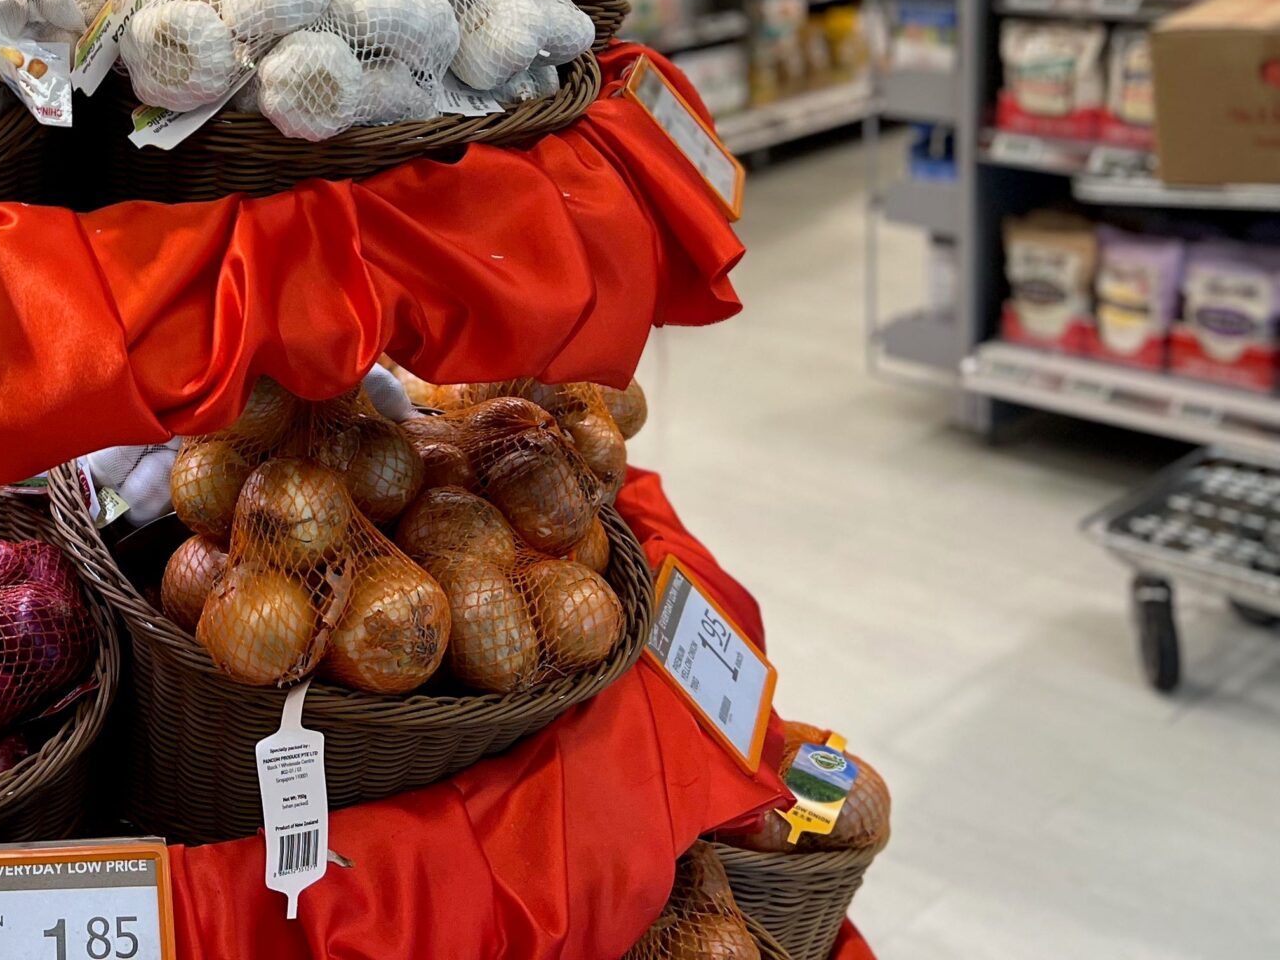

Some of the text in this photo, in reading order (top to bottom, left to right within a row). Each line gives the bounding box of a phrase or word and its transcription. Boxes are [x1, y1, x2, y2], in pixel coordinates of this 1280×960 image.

[36, 106, 63, 117] CHINA
[147, 110, 174, 128] Garlic
[659, 600, 674, 629] EVERYDAY
[673, 645, 685, 671] PREMIUM
[681, 640, 698, 679] YELLOW ONION
[281, 753, 300, 761] PRODUCE
[304, 819, 319, 827] Zealand
[807, 810, 831, 825] ONION
[67, 860, 104, 874] LOW
[106, 859, 148, 873] PRICE
[86, 916, 139, 960] 85
